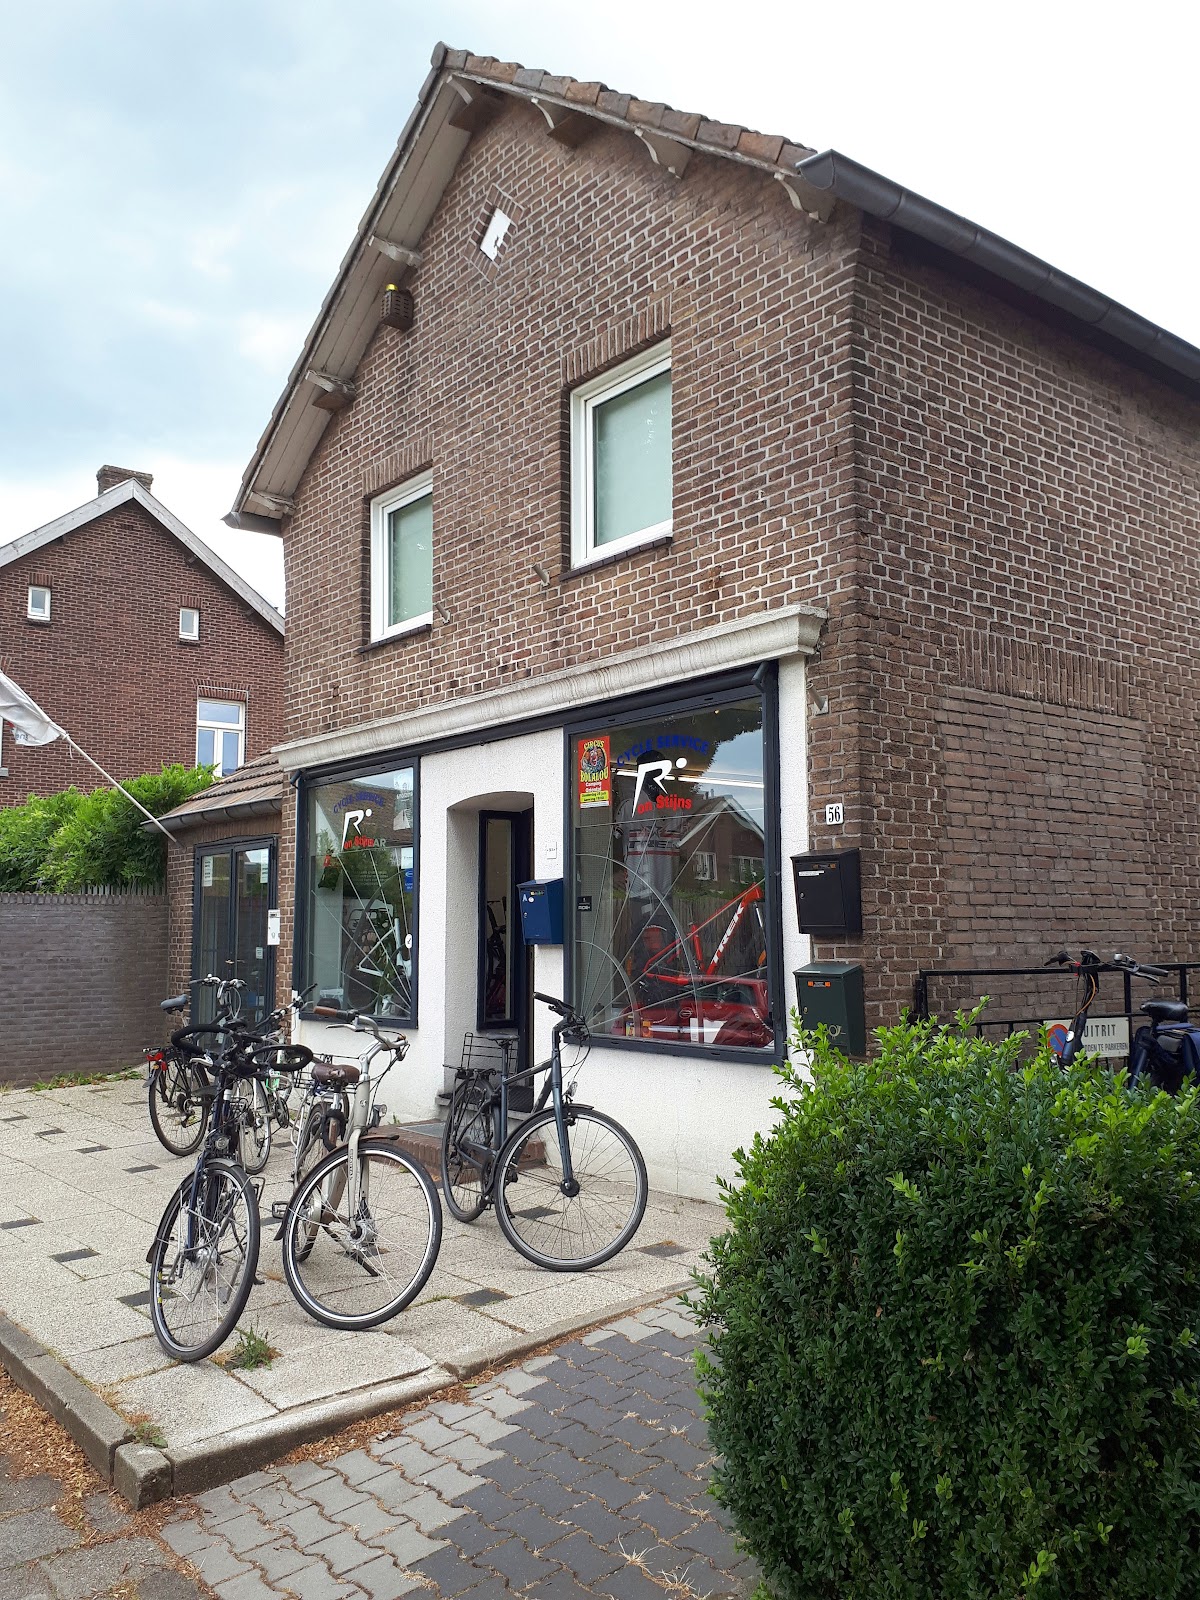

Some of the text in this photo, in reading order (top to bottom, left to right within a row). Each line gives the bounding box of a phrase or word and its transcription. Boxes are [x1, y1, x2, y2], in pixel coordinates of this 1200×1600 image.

[584, 740, 605, 751] CIRCUS
[617, 735, 710, 767] CYCLE SERVICE
[655, 793, 693, 811] Stijns
[828, 805, 841, 822] 56
[710, 902, 745, 965] TREK
[1084, 1024, 1116, 1038] UITRIT
